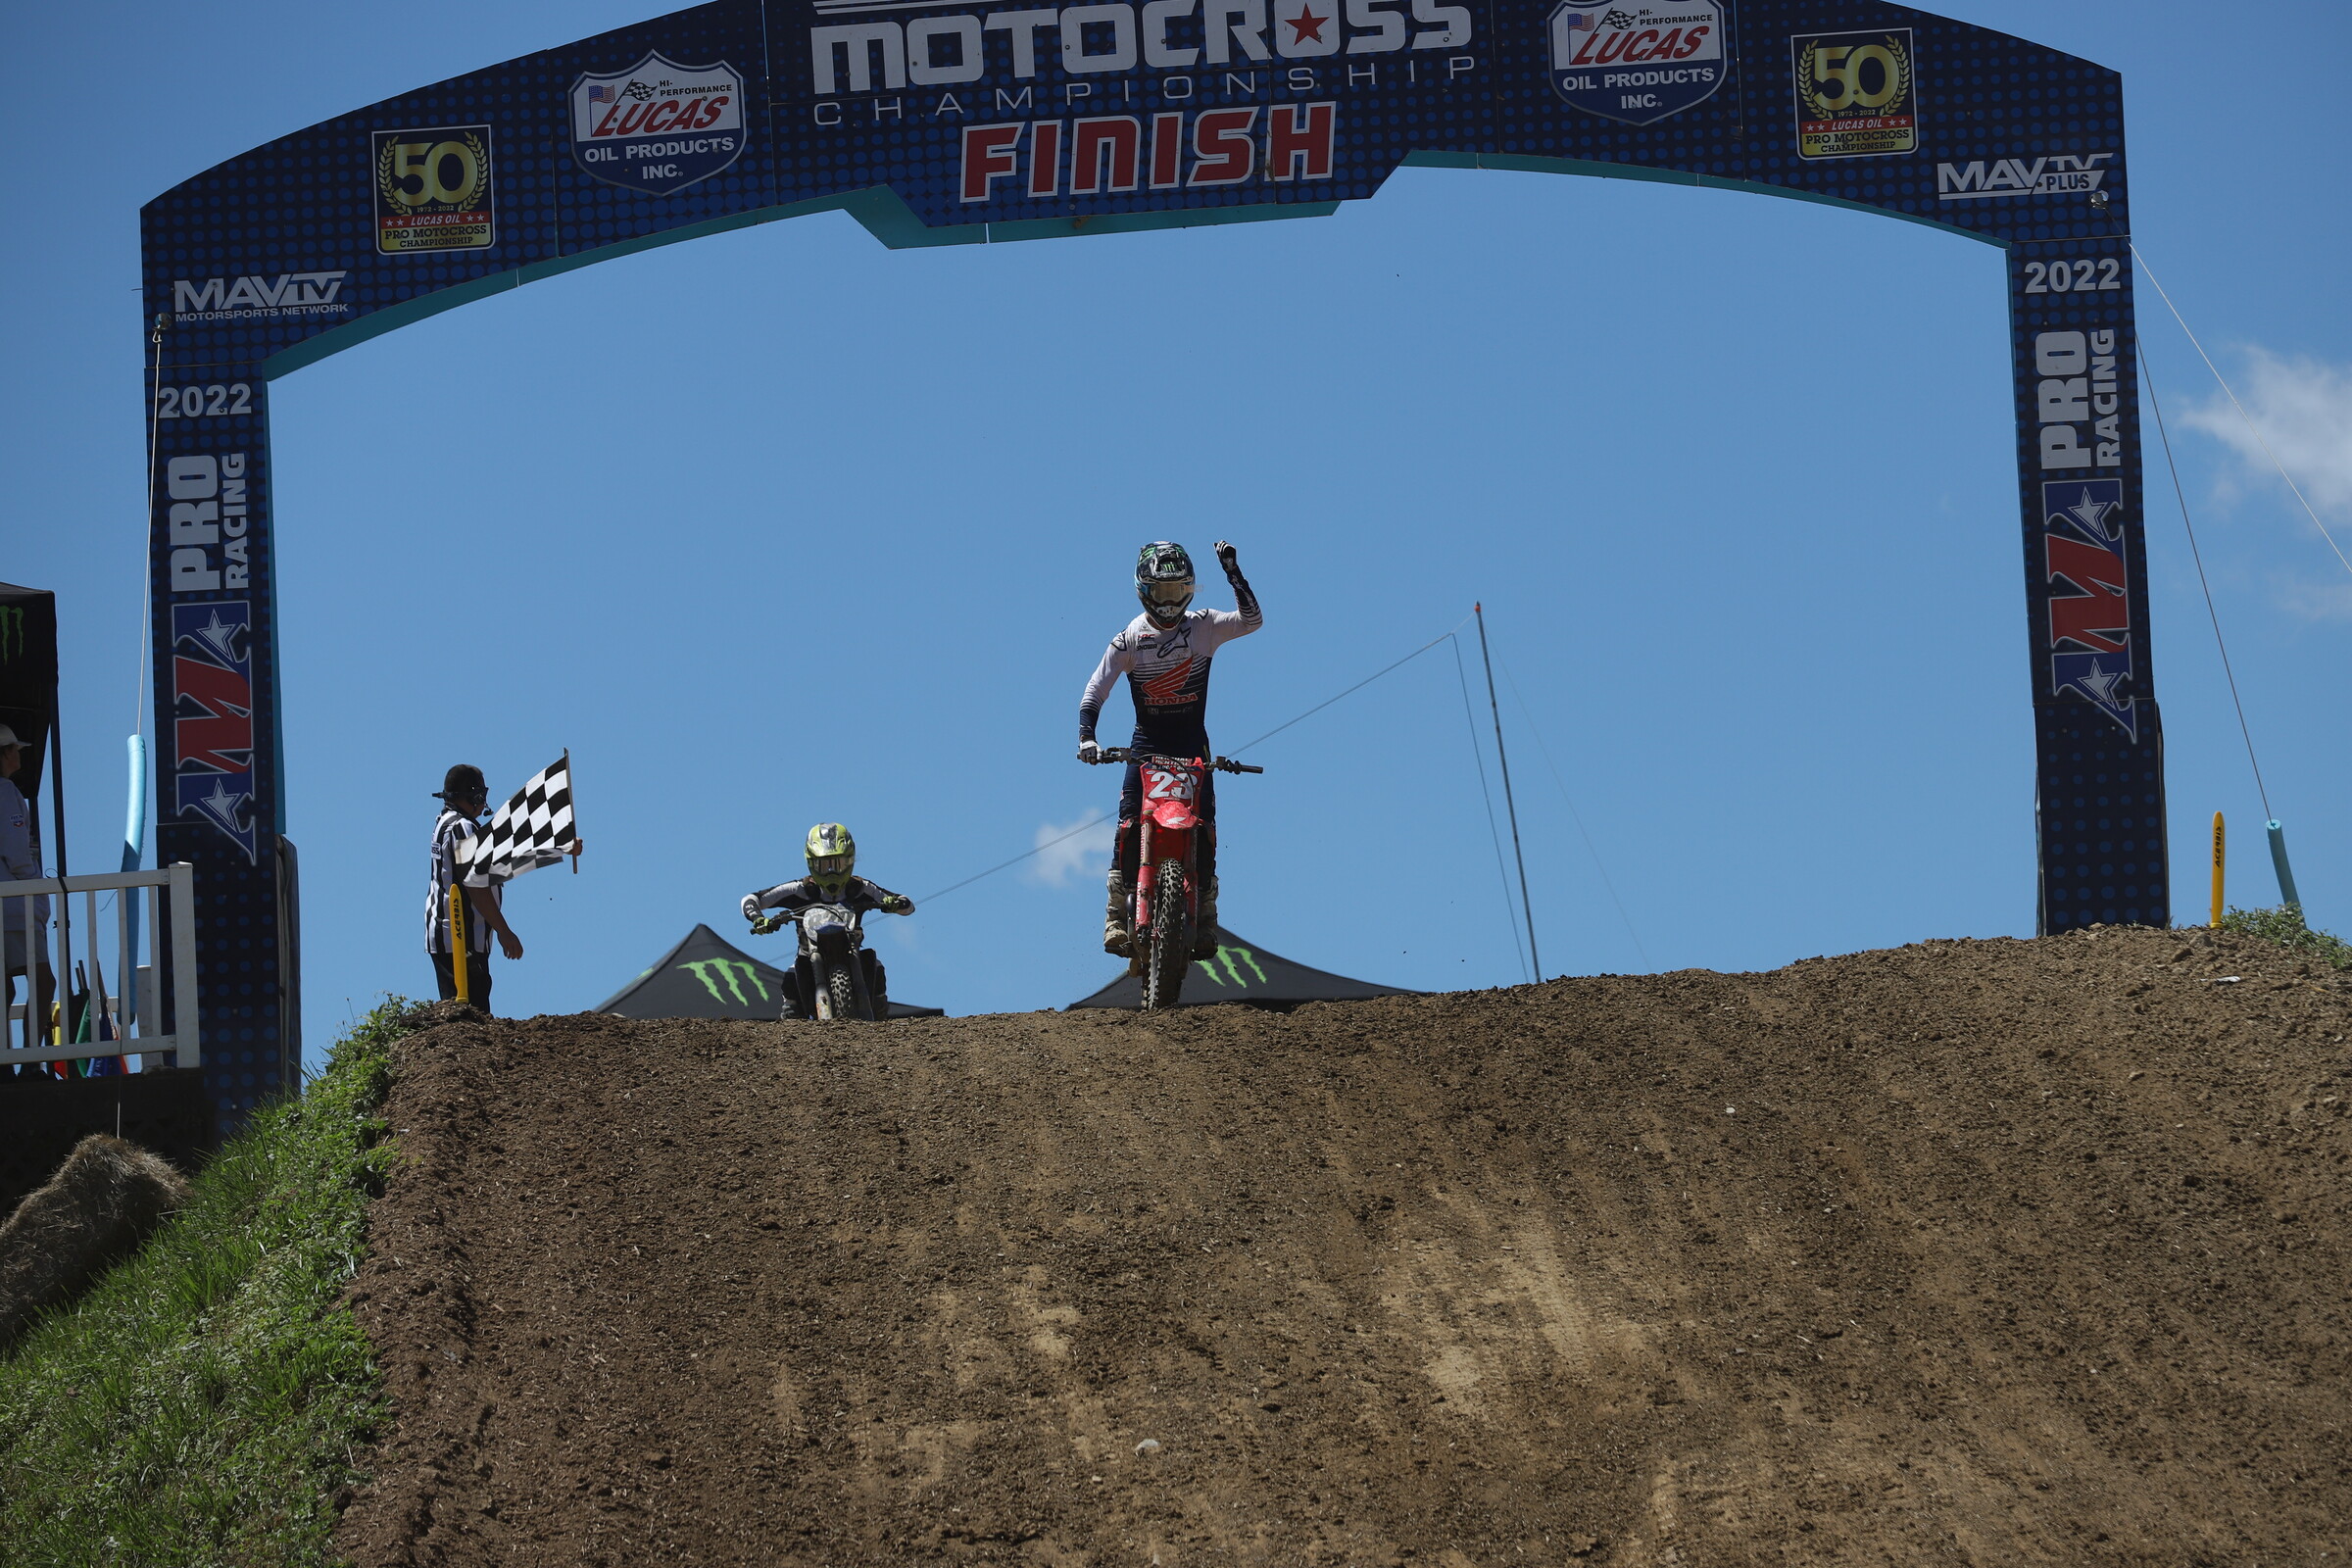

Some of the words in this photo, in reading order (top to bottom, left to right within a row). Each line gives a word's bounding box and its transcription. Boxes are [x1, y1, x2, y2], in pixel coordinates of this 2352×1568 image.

[1640, 14, 1713, 25] PERFORMANCE
[810, 0, 1472, 94] MOTOCROSS
[1570, 25, 1710, 66] LUCAS
[660, 84, 733, 97] PERFORMANCE
[813, 55, 1475, 125] CHAMPIONSHIP
[1562, 75, 1597, 91] OIL
[1604, 68, 1715, 88] PRODUCTS
[1813, 44, 1900, 111] 50
[591, 95, 730, 137] LUCAS
[1832, 120, 1864, 130] LUCAS
[1866, 119, 1883, 128] OIL
[584, 147, 619, 163] OIL
[625, 137, 735, 160] PRODUCTS
[959, 101, 1337, 204] FINISH
[1805, 134, 1831, 144] PRO
[1834, 129, 1909, 143] MOTOCROSS
[1821, 141, 1896, 153] CHAMPIONSHIP
[393, 141, 478, 206] 50
[1936, 153, 2114, 193] MAVTV
[2046, 173, 2090, 191] PLUS
[384, 229, 410, 240] PRO
[413, 224, 487, 238] MOTOCROSS
[411, 215, 443, 226] LUCAS
[445, 215, 461, 224] OIL
[399, 236, 473, 248] CHAMPIONSHIP
[173, 270, 347, 313] MAVTV
[2025, 258, 2121, 294] 2022
[175, 308, 279, 322] MOTORSPORTS
[282, 303, 349, 316] NETWORK
[158, 383, 252, 418] 2022
[2034, 330, 2092, 469] PRO
[2090, 328, 2121, 466] RACING
[168, 455, 220, 592] PRO
[221, 453, 249, 589] RACING
[1145, 692, 1198, 706] HONDA
[1148, 771, 1198, 800] 23
[453, 898, 463, 940] ACERBIS
